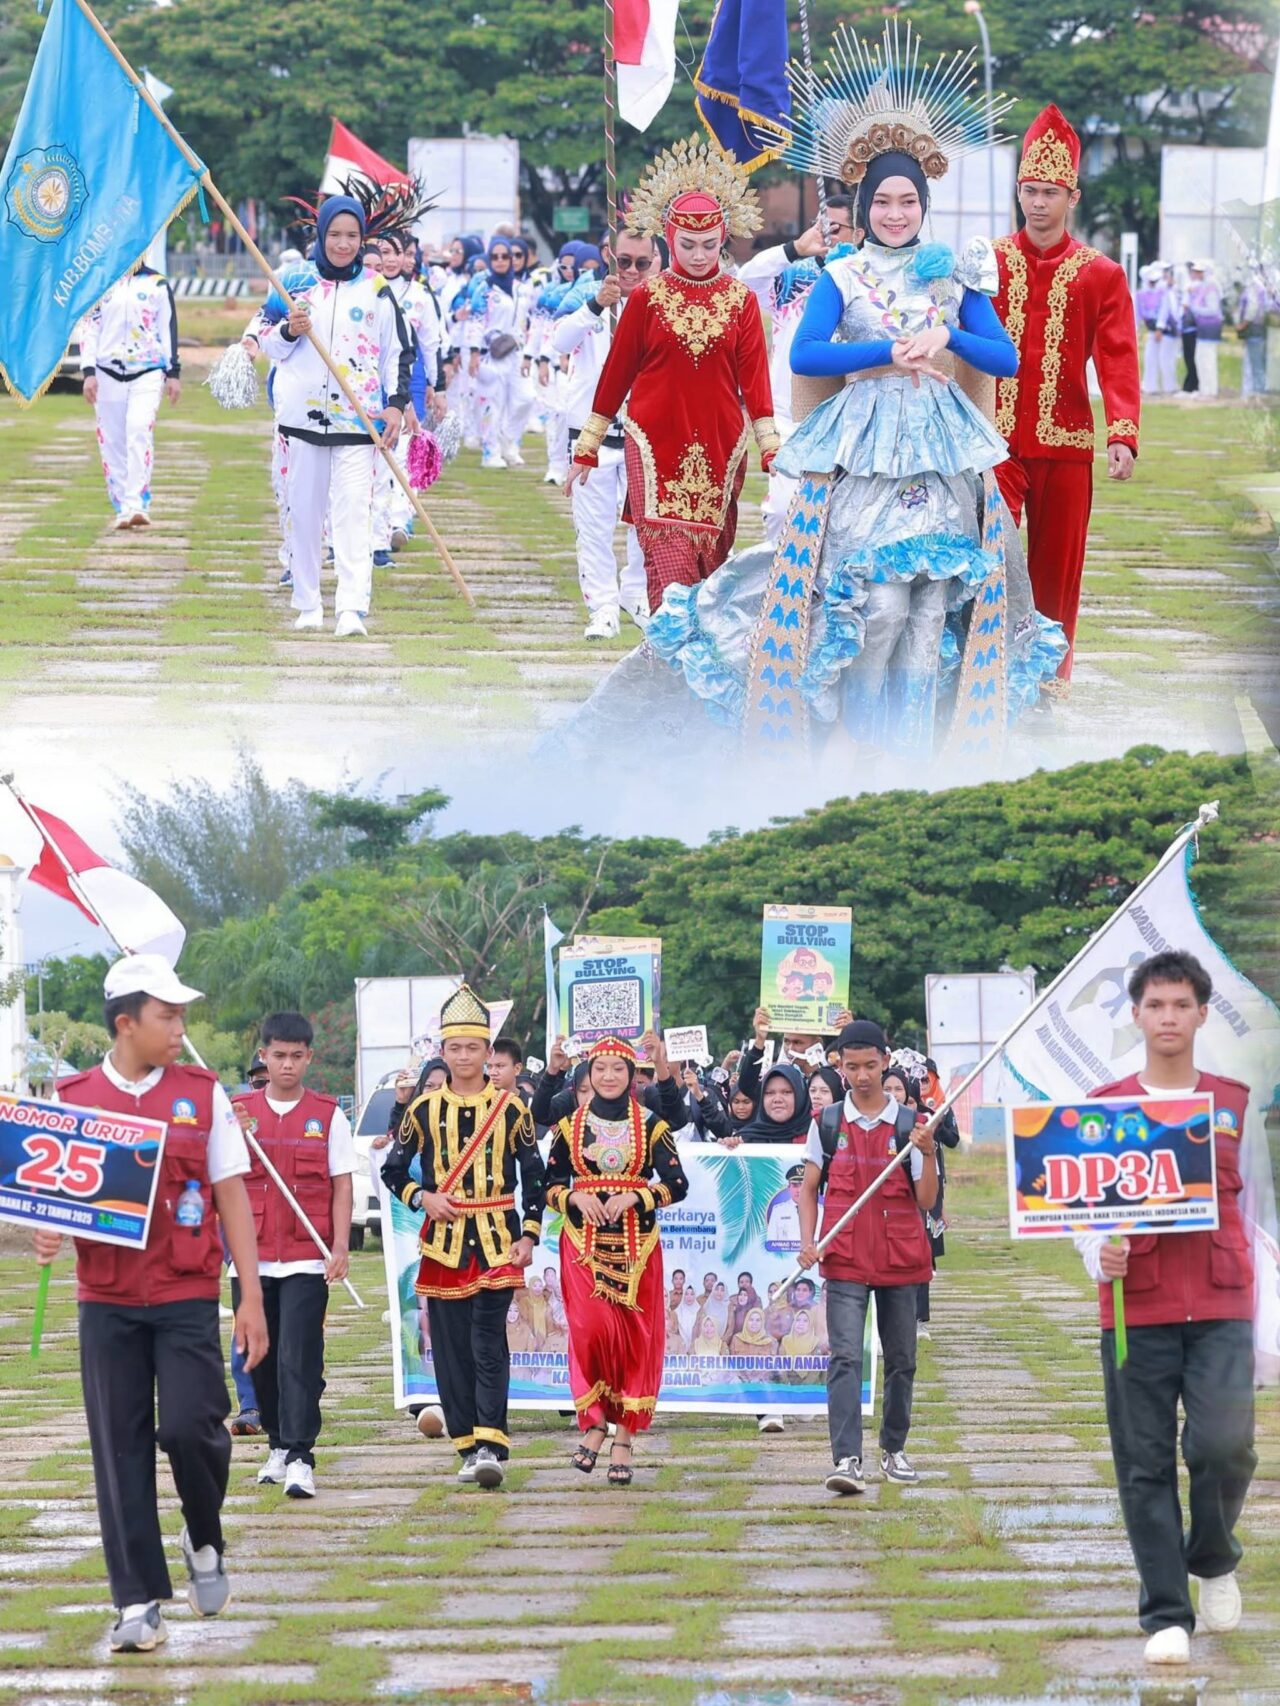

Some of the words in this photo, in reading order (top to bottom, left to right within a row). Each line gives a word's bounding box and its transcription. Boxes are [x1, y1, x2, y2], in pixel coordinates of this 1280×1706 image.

[785, 924, 829, 937] STOP
[777, 936, 836, 947] BULLYING
[583, 957, 628, 970] STOP
[575, 966, 637, 978] BULLYING
[0, 1105, 75, 1132] NOMOR
[83, 1121, 141, 1144] URUT
[19, 1135, 104, 1195] 25
[1045, 1152, 1182, 1201] DP3A
[36, 1202, 47, 1215] 22
[71, 1210, 93, 1225] 2025
[657, 1208, 716, 1226] Berkarya
[679, 1237, 716, 1254] Maju
[690, 1356, 793, 1370] PERLINDUNGAN
[661, 1373, 700, 1386] BANA
